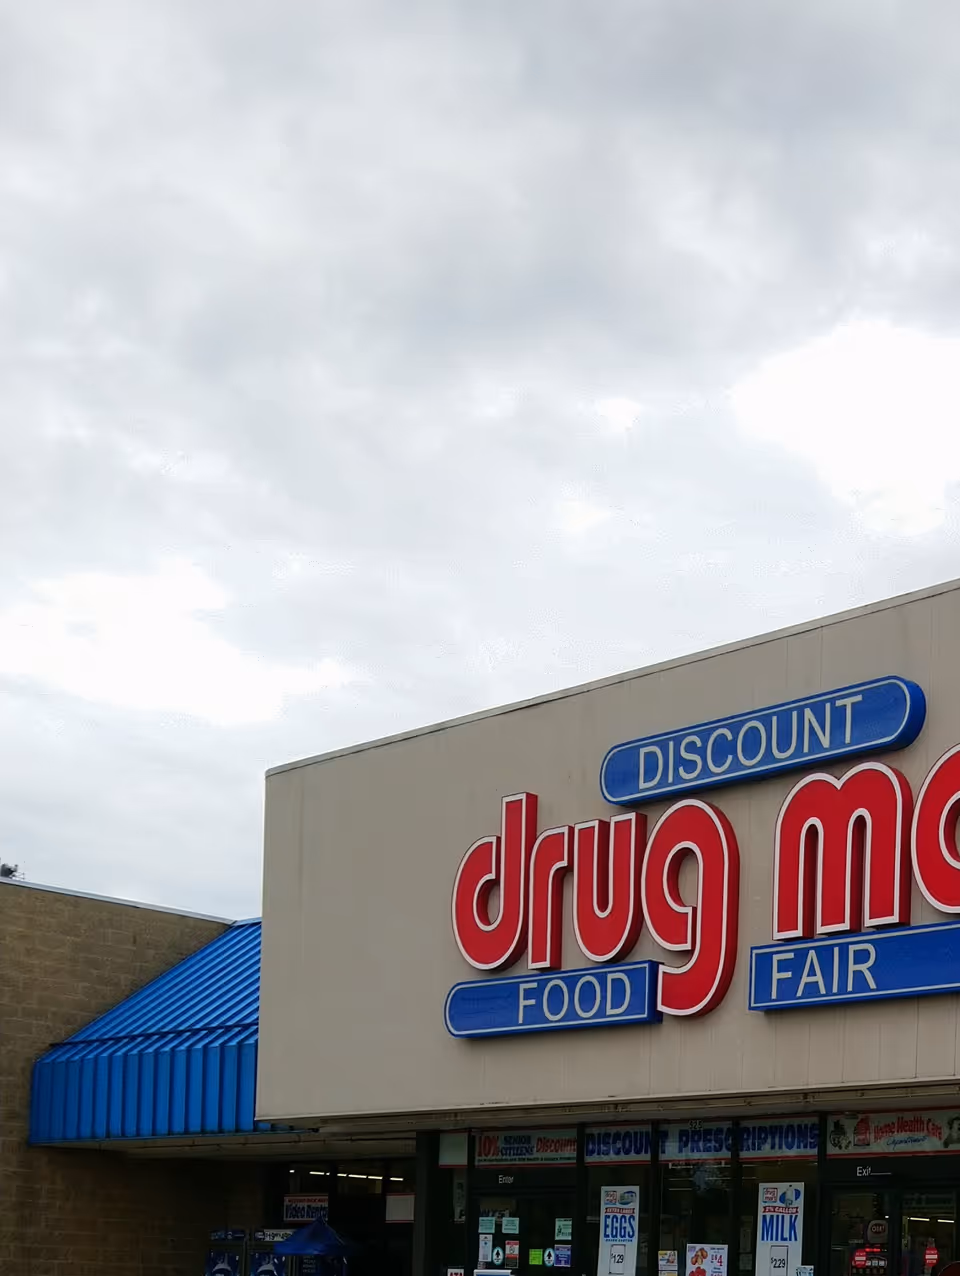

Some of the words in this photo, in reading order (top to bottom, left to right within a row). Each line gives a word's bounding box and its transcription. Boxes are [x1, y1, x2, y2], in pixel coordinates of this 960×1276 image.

[637, 694, 863, 789] DISCOUNT
[451, 792, 740, 1017] drug
[517, 972, 631, 1025] FOOD
[770, 942, 878, 1000] FAIR
[586, 1131, 669, 1156] DISCOUNT
[678, 1123, 820, 1154] PRESCRIPTIONS
[926, 1118, 944, 1141] Care
[477, 1136, 499, 1157] 10%
[498, 1174, 515, 1184] Enter
[856, 1166, 872, 1177] Exit
[603, 1215, 636, 1238] EGGS
[761, 1215, 798, 1241] MILK
